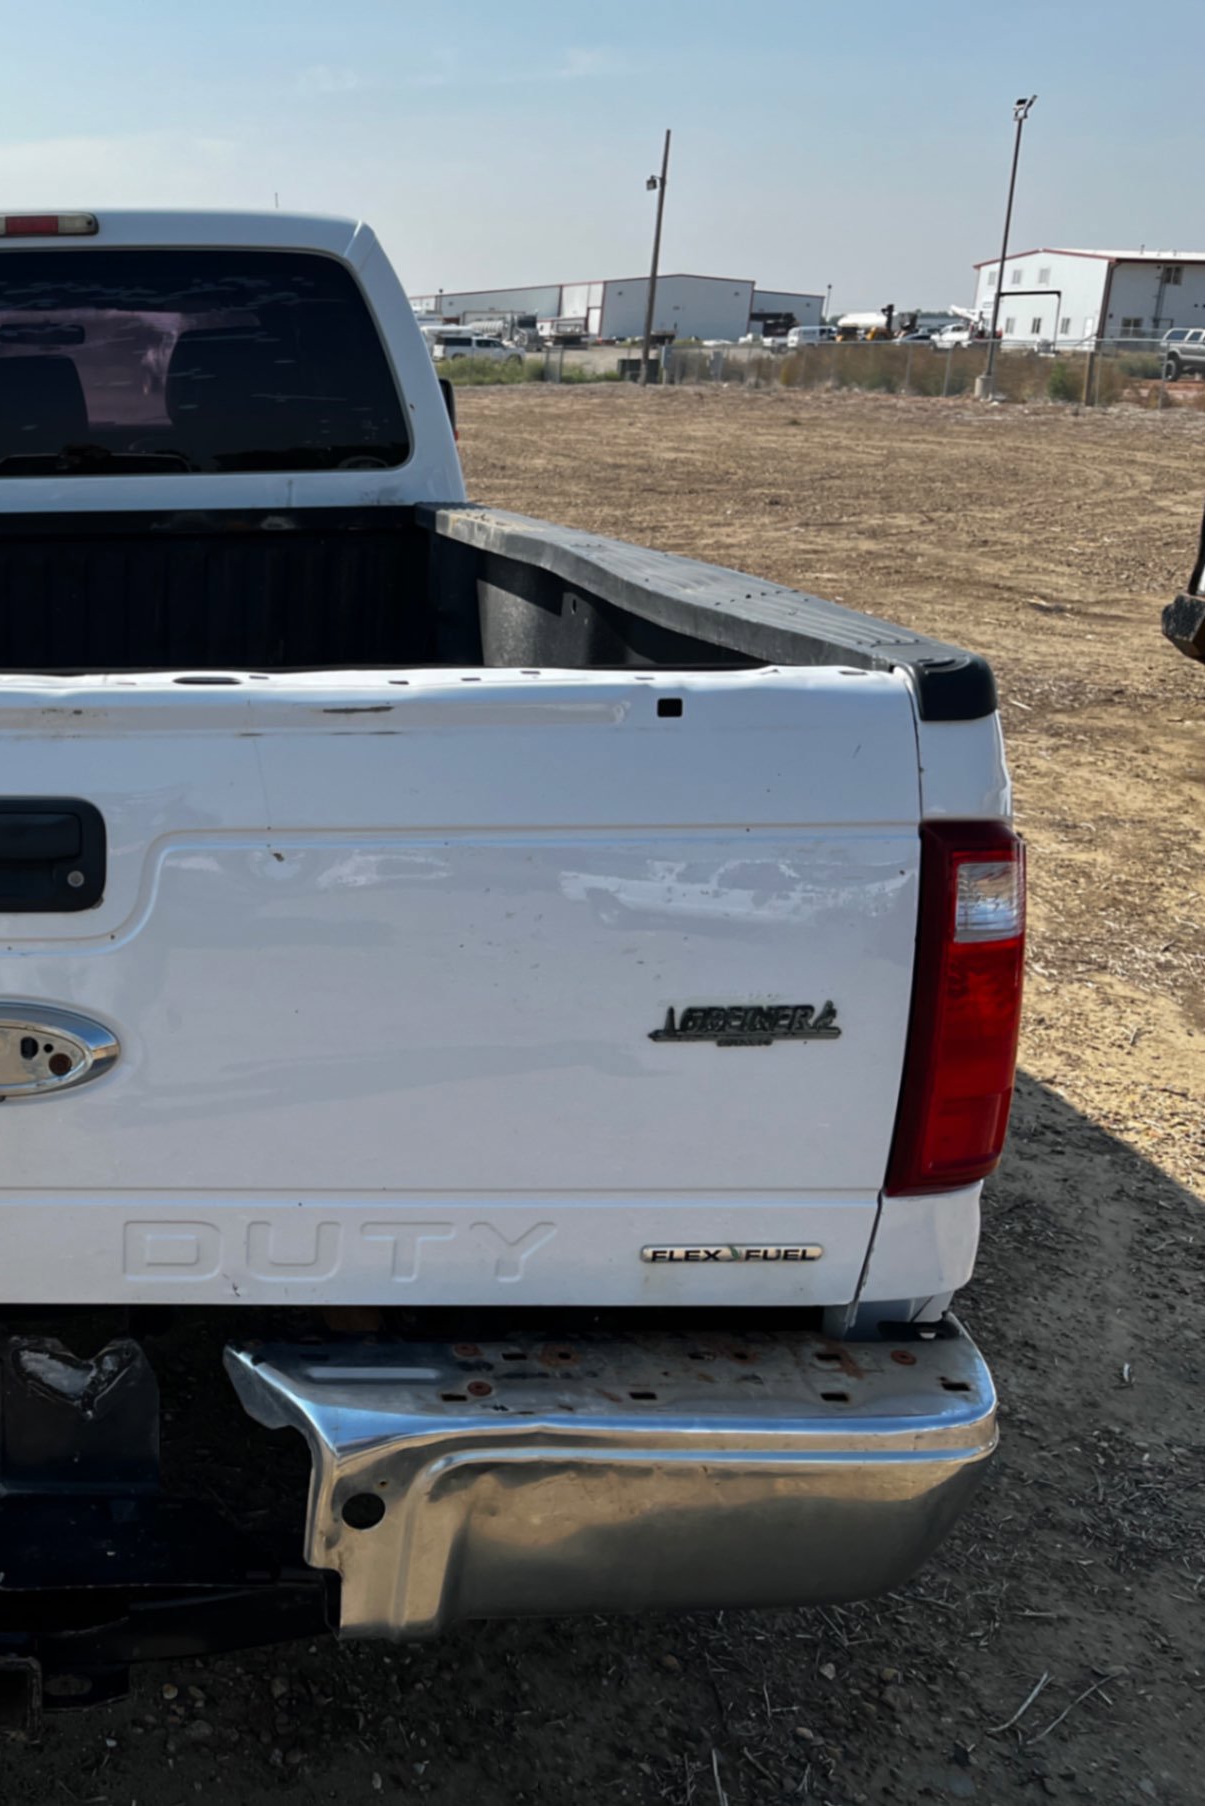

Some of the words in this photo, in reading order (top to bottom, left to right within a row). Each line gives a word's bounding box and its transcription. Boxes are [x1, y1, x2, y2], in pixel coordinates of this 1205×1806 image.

[122, 1219, 558, 1283] DUTY
[650, 1249, 723, 1263] FLEX
[745, 1248, 817, 1262] FUEL
